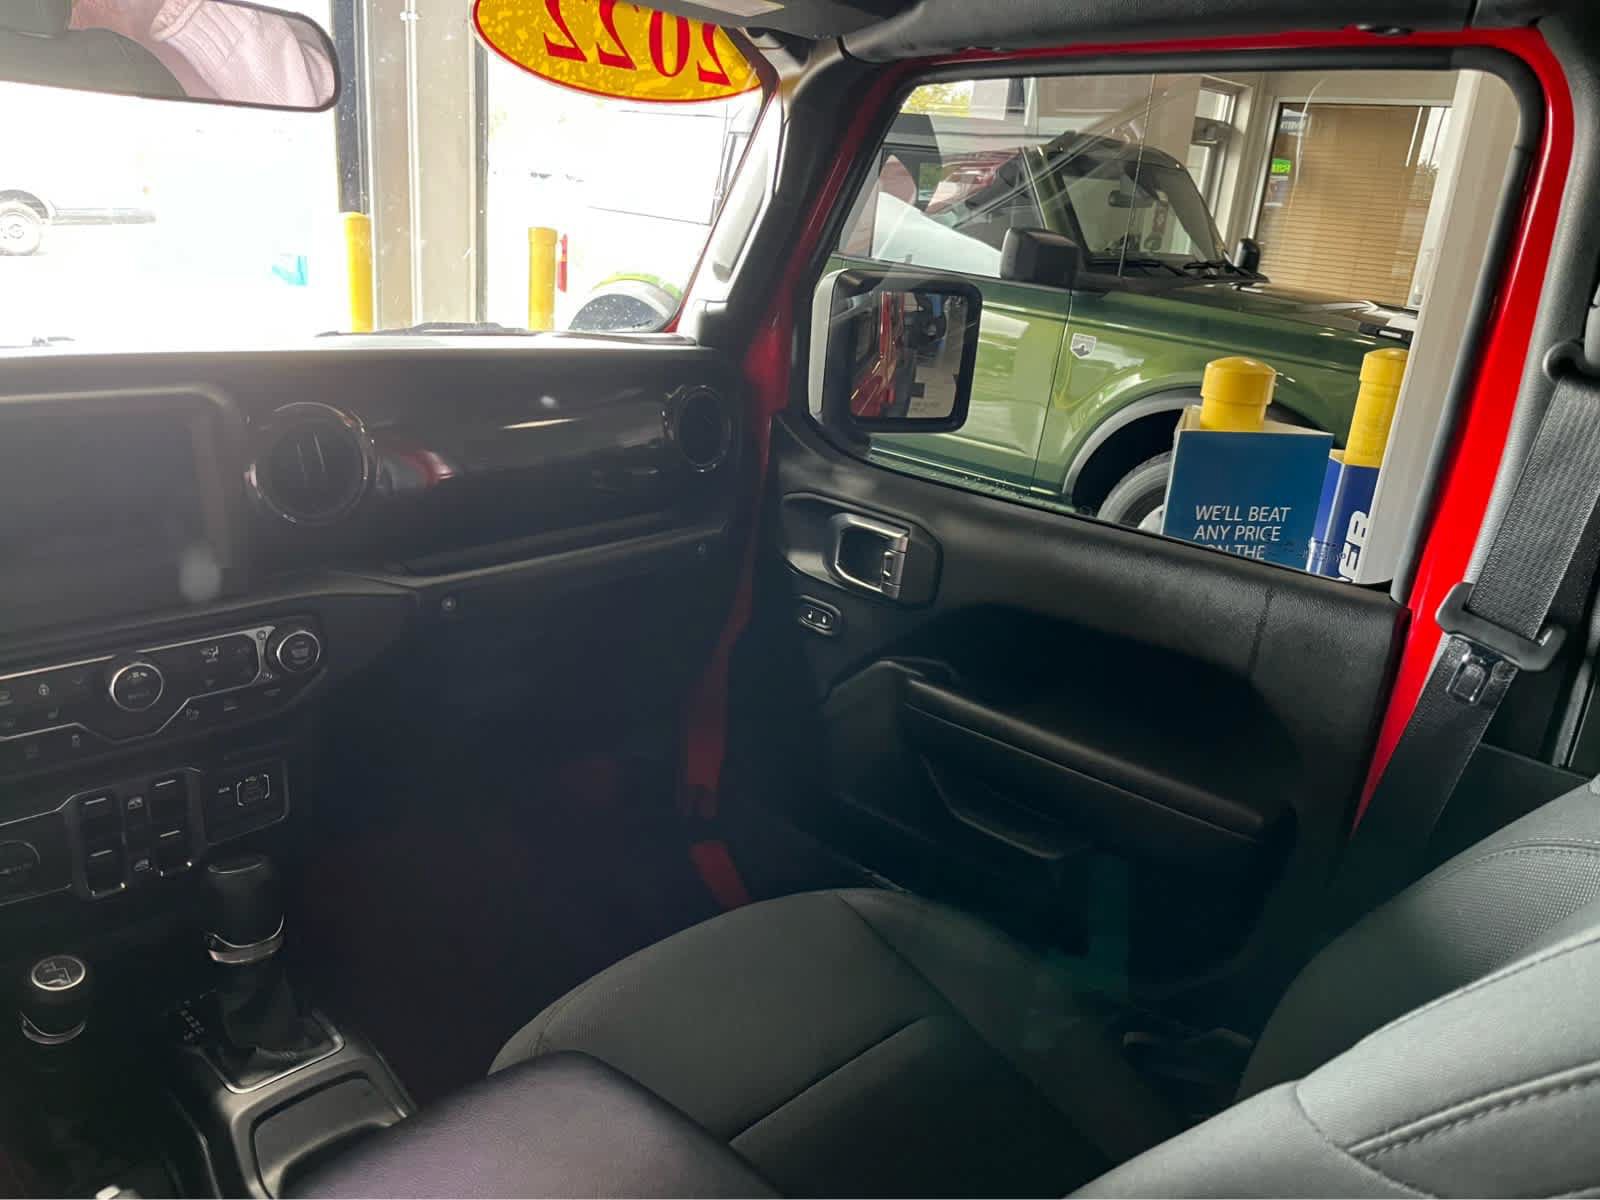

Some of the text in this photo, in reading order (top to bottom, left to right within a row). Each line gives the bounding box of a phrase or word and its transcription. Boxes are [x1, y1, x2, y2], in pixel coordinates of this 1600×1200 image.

[1195, 505, 1292, 522] WE'LL BEAT
[1193, 524, 1281, 542] ANY PRICE
[1234, 544, 1265, 560] THE
